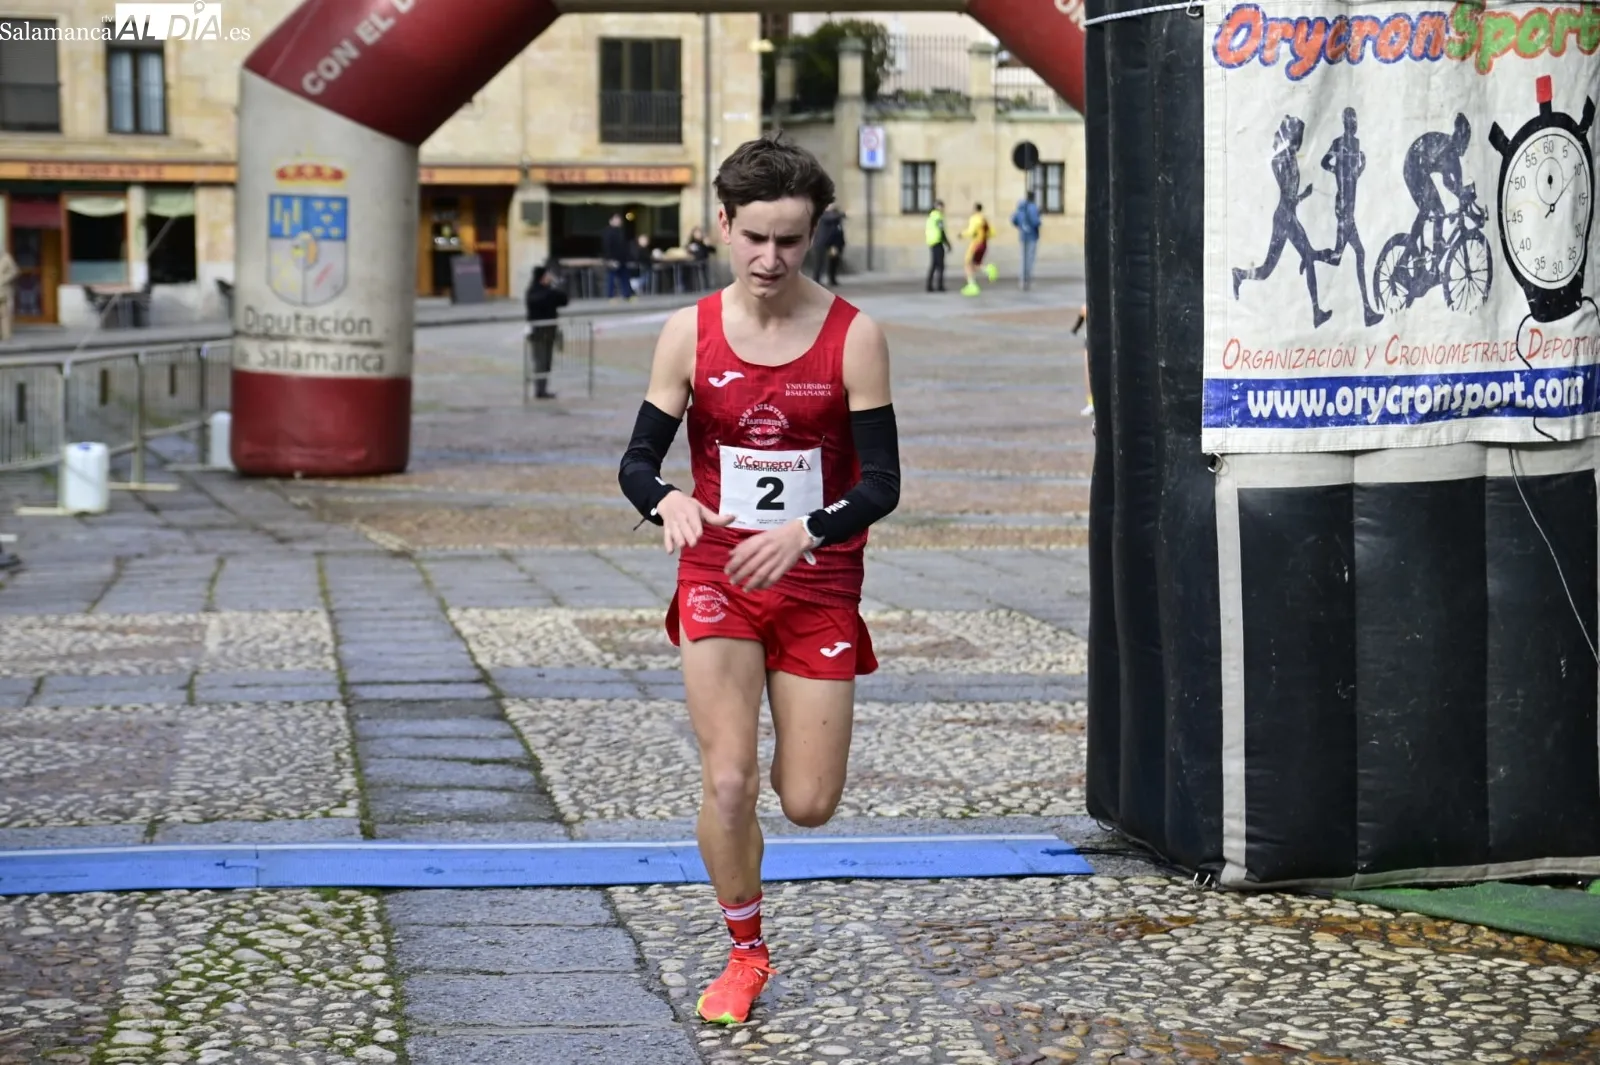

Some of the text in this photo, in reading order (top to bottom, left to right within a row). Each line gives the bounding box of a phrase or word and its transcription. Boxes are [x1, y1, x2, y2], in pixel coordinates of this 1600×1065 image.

[301, 12, 397, 95] CON EL
[1542, 139, 1555, 155] 60
[1524, 152, 1538, 169] 55
[1513, 175, 1527, 190] 50
[1511, 210, 1524, 224] 45
[1519, 237, 1532, 252] 40
[1534, 256, 1547, 271] 35
[1551, 259, 1563, 275] 30
[257, 342, 384, 371] Salamanca
[1246, 372, 1585, 423] www.orycronsport.com
[755, 476, 785, 511] 2
